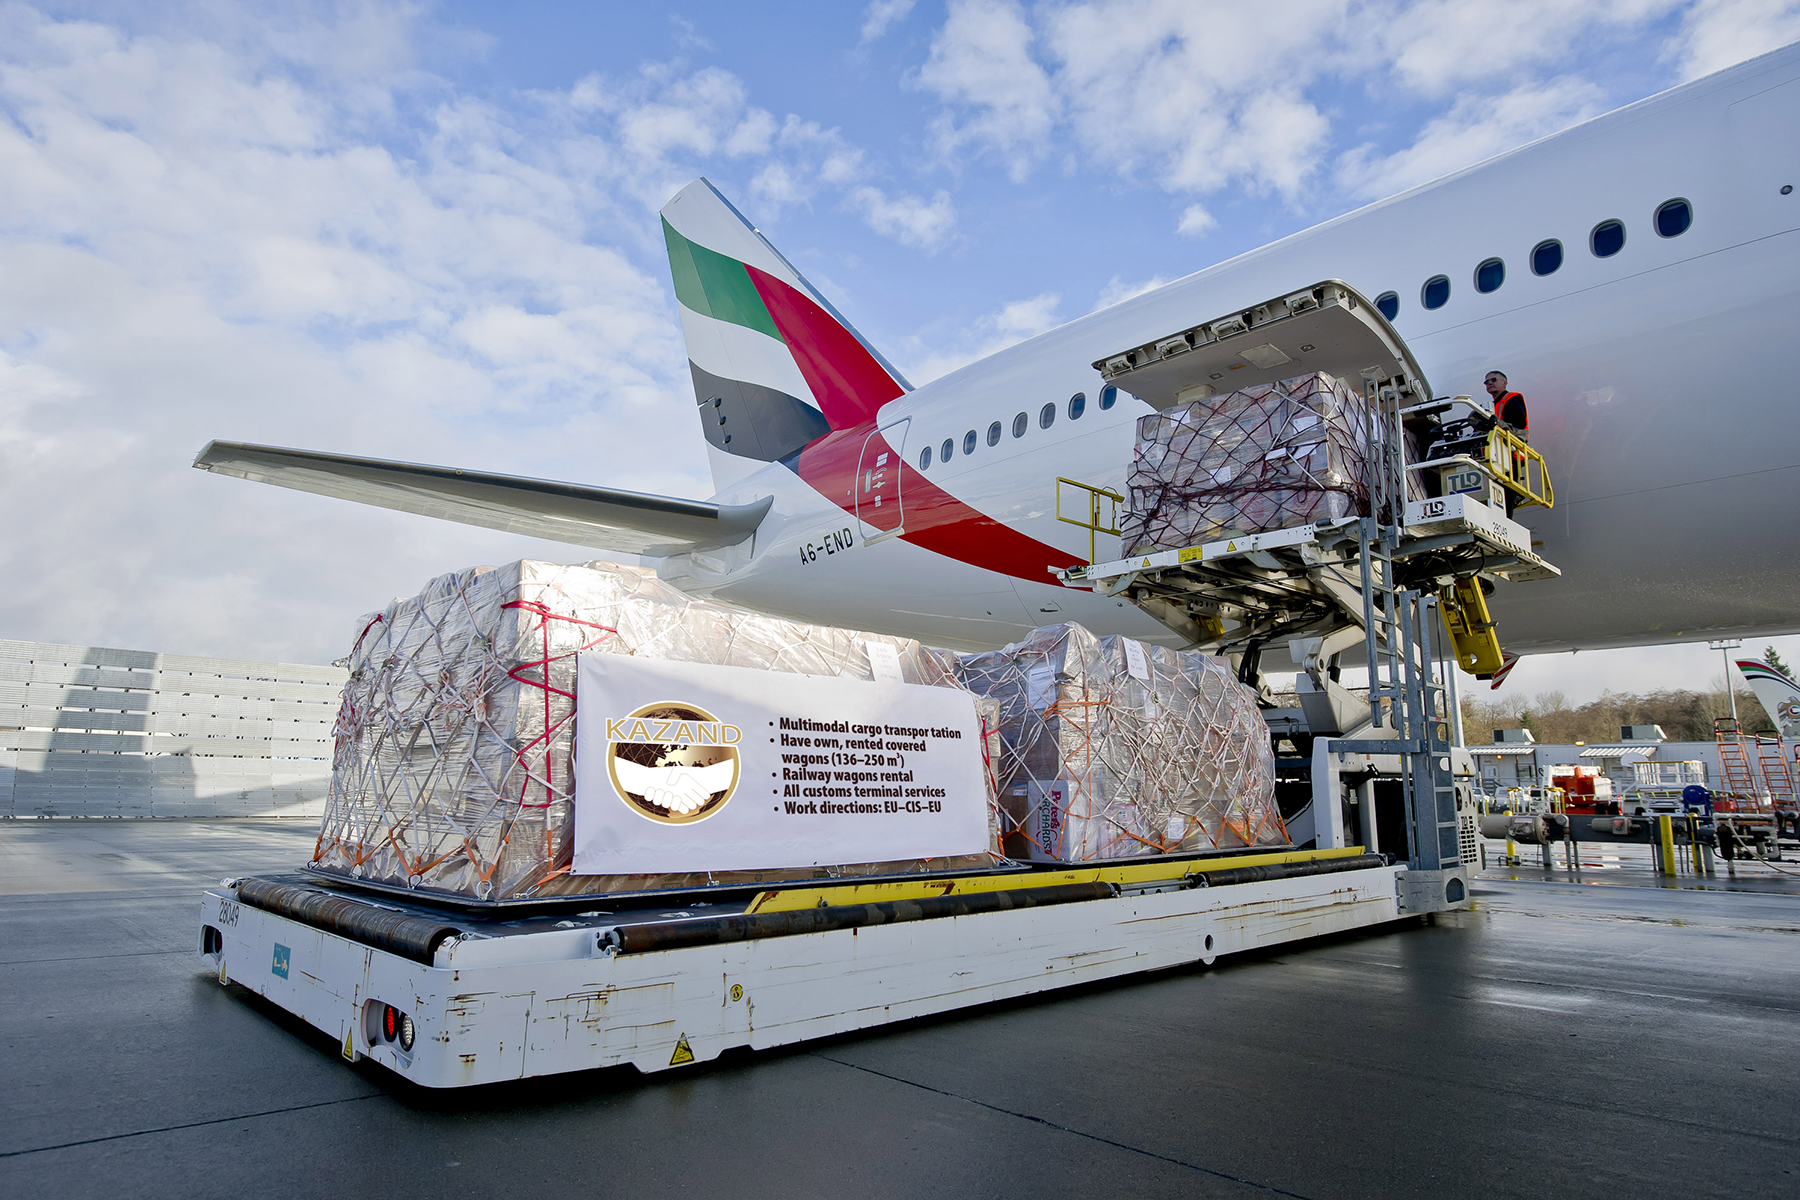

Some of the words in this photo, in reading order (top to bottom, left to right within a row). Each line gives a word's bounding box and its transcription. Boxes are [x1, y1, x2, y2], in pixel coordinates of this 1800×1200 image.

[1448, 472, 1482, 492] TLD
[1420, 501, 1446, 516] TLD
[799, 527, 853, 566] A6-END
[606, 718, 742, 744] KAZAND
[779, 717, 849, 733] Multimodal
[851, 723, 882, 737] cargo
[780, 733, 811, 748] Have
[814, 736, 843, 750] own,
[845, 738, 883, 750] rented
[885, 740, 927, 752] covered
[782, 754, 830, 767] wagons
[782, 767, 831, 784] Railway
[833, 771, 878, 784] wagons
[880, 770, 914, 782] rental
[783, 784, 800, 798] All
[802, 786, 852, 798] customs
[854, 785, 903, 798] terminal
[904, 786, 946, 798] services
[784, 801, 817, 814] Work
[819, 801, 882, 814] directions:
